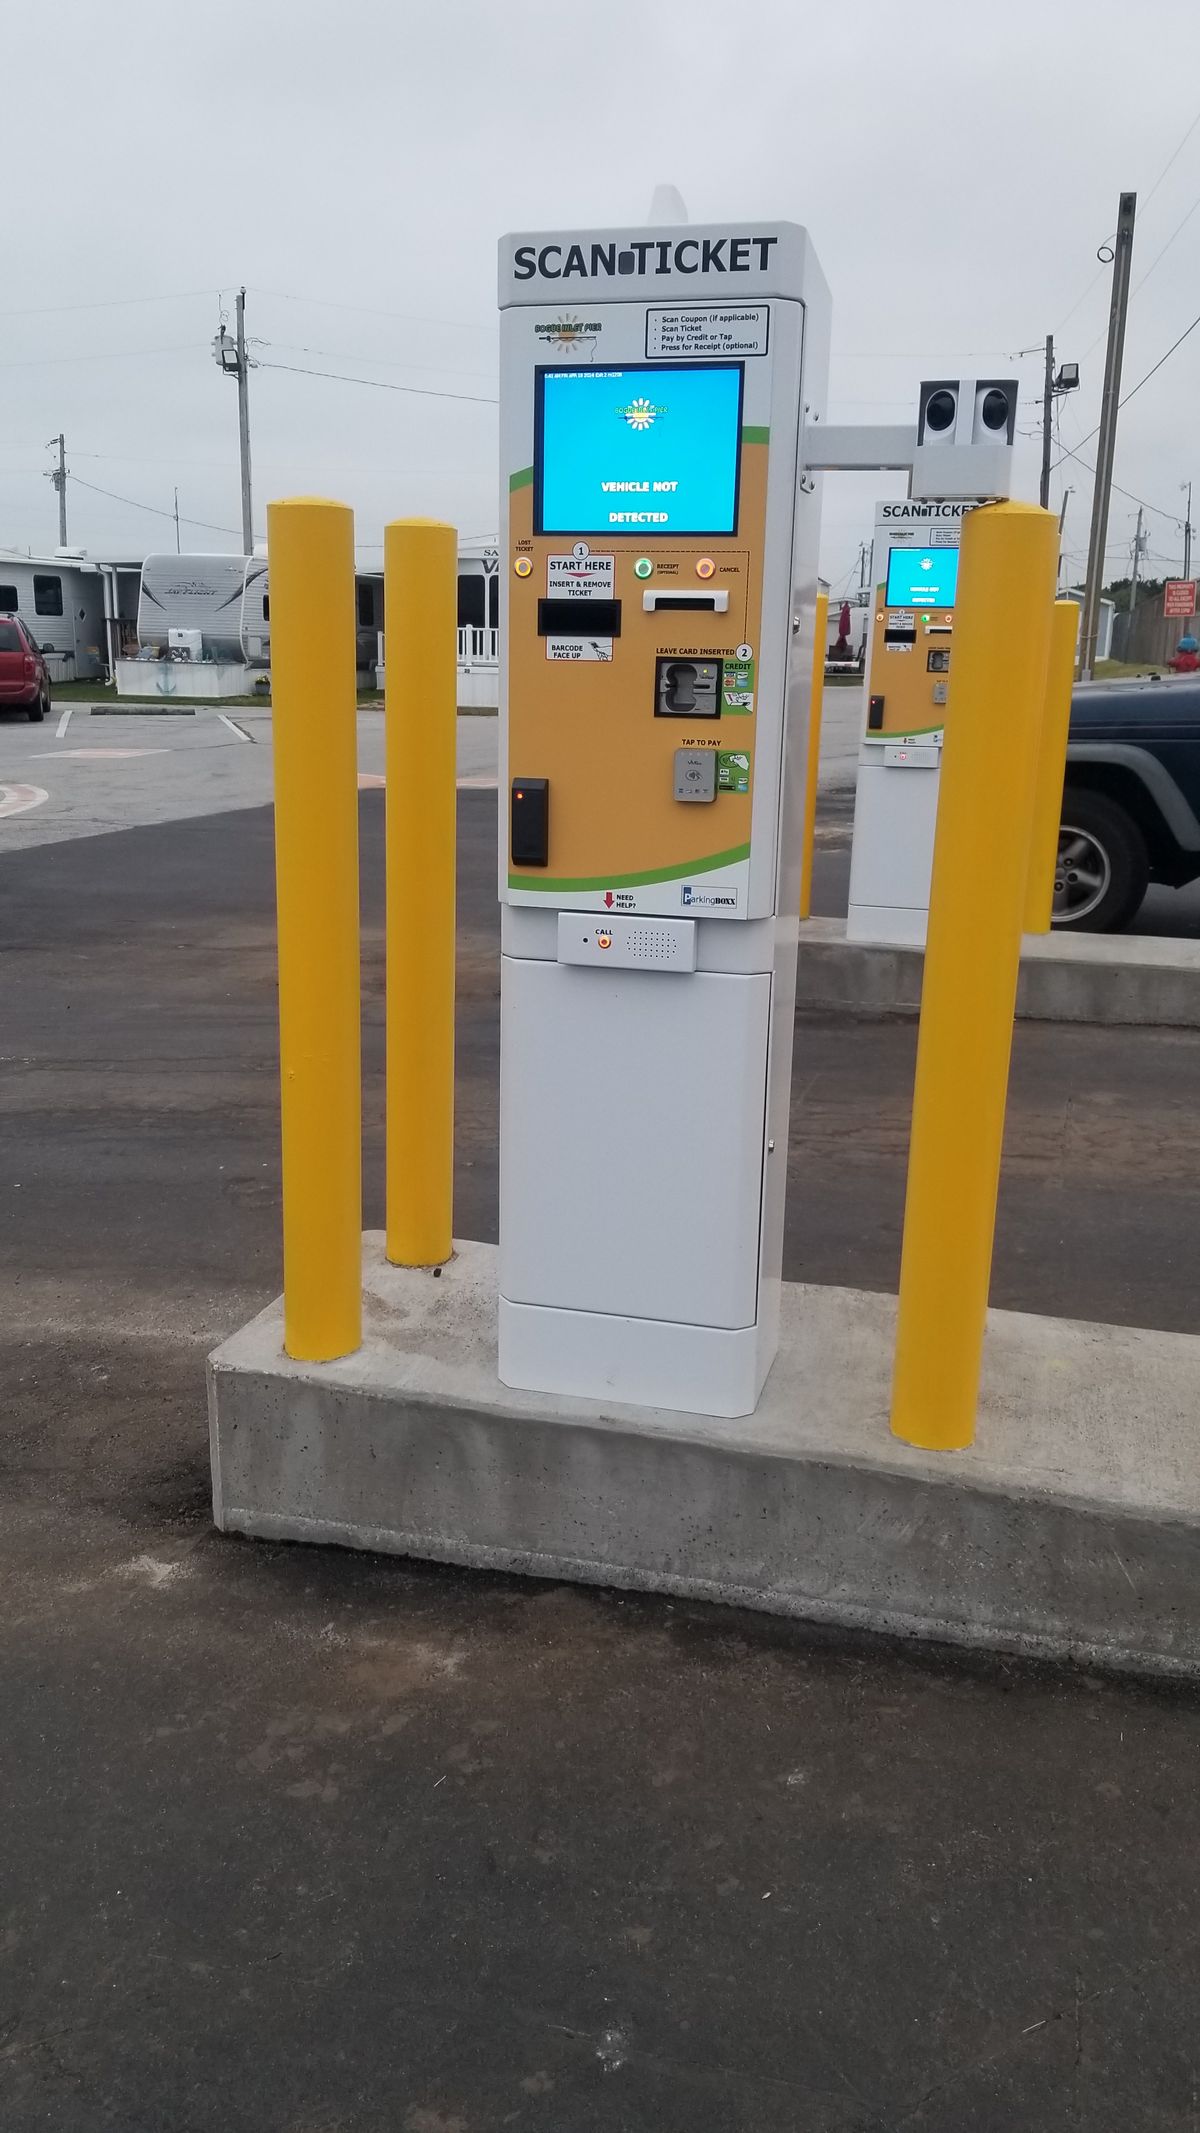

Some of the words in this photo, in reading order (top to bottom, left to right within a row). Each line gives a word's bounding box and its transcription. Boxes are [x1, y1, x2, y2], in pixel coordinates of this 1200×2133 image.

[514, 243, 616, 280] SCAN
[630, 237, 778, 275] TICKET
[680, 315, 708, 323] Coupon
[709, 314, 718, 323] (if
[719, 313, 759, 322] applicable)
[661, 335, 674, 343] Pay
[676, 334, 685, 342] by
[686, 333, 708, 341] Credit
[719, 333, 733, 341] Tap
[694, 342, 721, 351] Receipt
[722, 341, 759, 350] (optional)
[601, 481, 650, 492] VEHICLE
[652, 481, 679, 492] NOT
[882, 505, 921, 518] SCAN
[609, 512, 669, 523] DETECTED
[578, 547, 584, 556] 1
[550, 561, 582, 571] START
[584, 561, 612, 571] HERE
[549, 580, 575, 588] INSERT
[576, 580, 581, 588] &
[741, 648, 748, 657] 2
